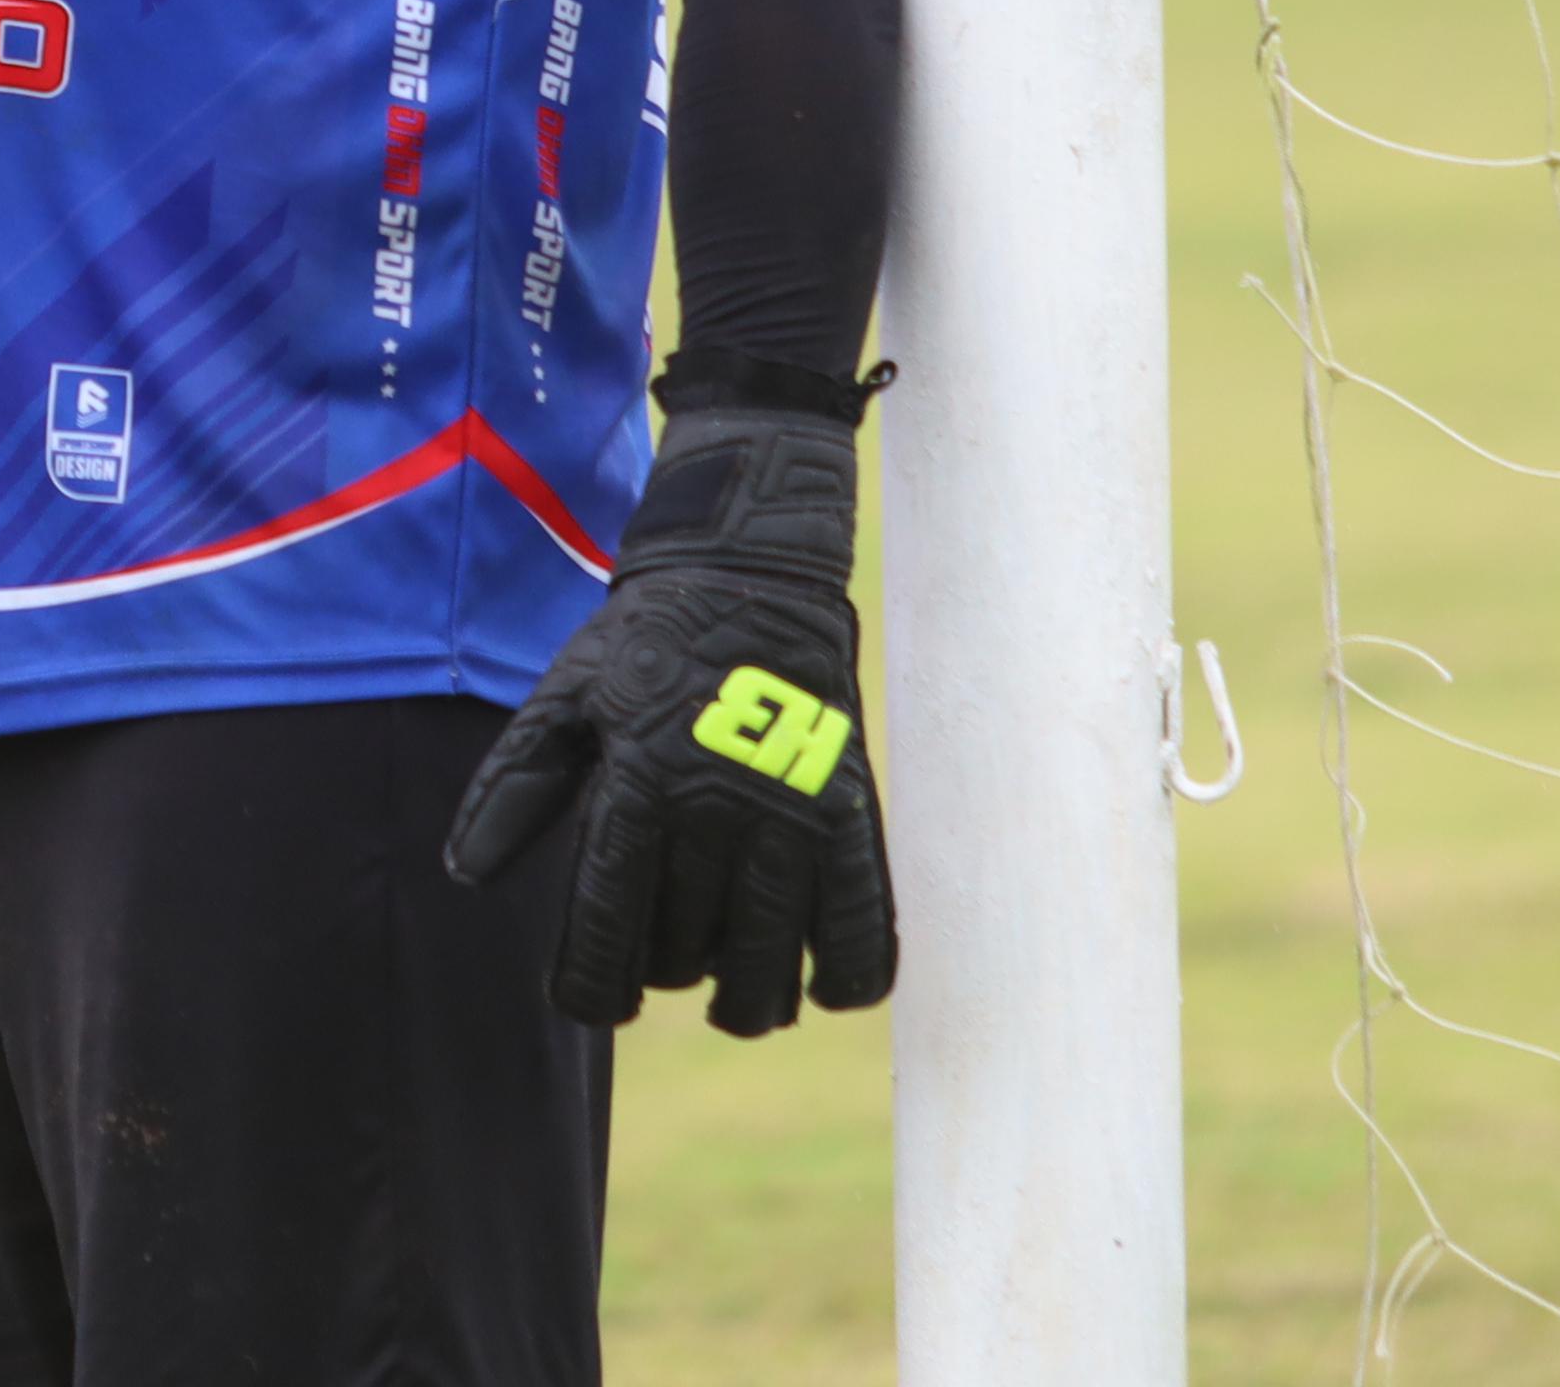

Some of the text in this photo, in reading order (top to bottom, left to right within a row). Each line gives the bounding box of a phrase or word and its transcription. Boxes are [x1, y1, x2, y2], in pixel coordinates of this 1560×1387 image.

[373, 198, 417, 328] SPORT
[522, 201, 565, 332] SPORT
[55, 455, 116, 482] DESIGN
